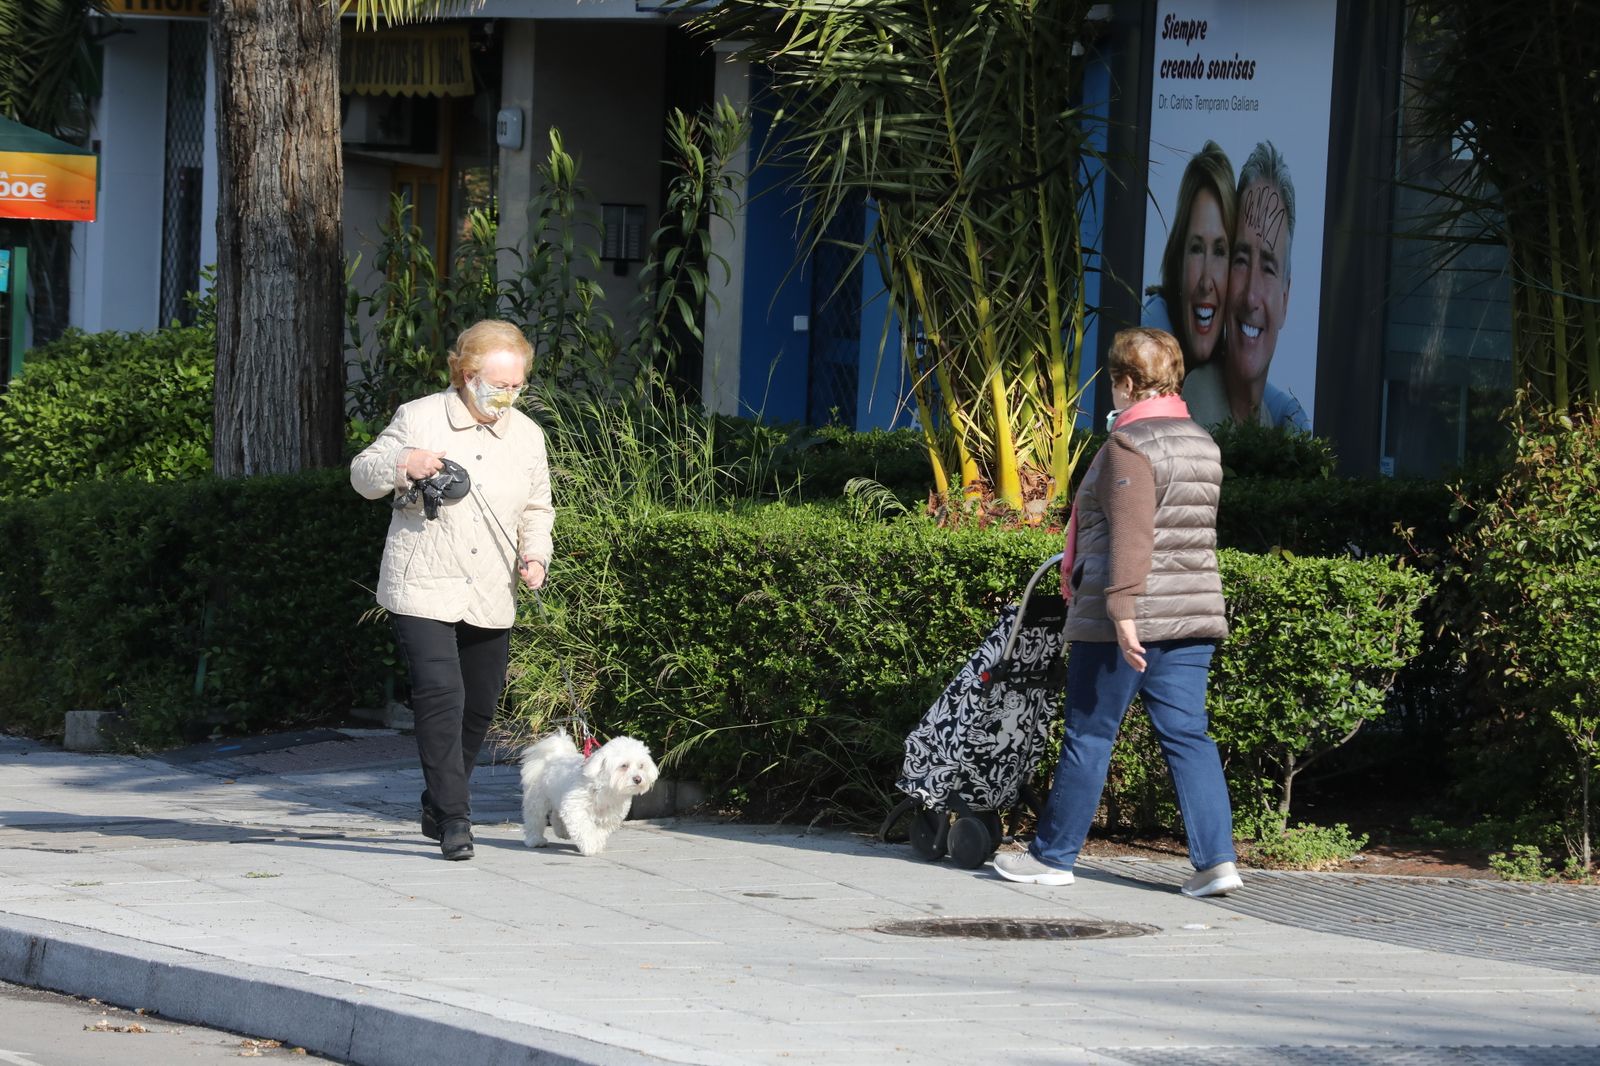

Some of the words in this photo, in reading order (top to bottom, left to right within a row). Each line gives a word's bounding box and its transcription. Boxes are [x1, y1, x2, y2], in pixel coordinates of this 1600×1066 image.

[1162, 13, 1208, 47] Siempre
[1160, 52, 1205, 80] creando
[1207, 52, 1256, 81] sonrisas
[1158, 94, 1168, 110] Dr.
[1170, 94, 1193, 111] Carlos
[1194, 94, 1229, 114] Temprano
[1231, 95, 1259, 112] Galiana
